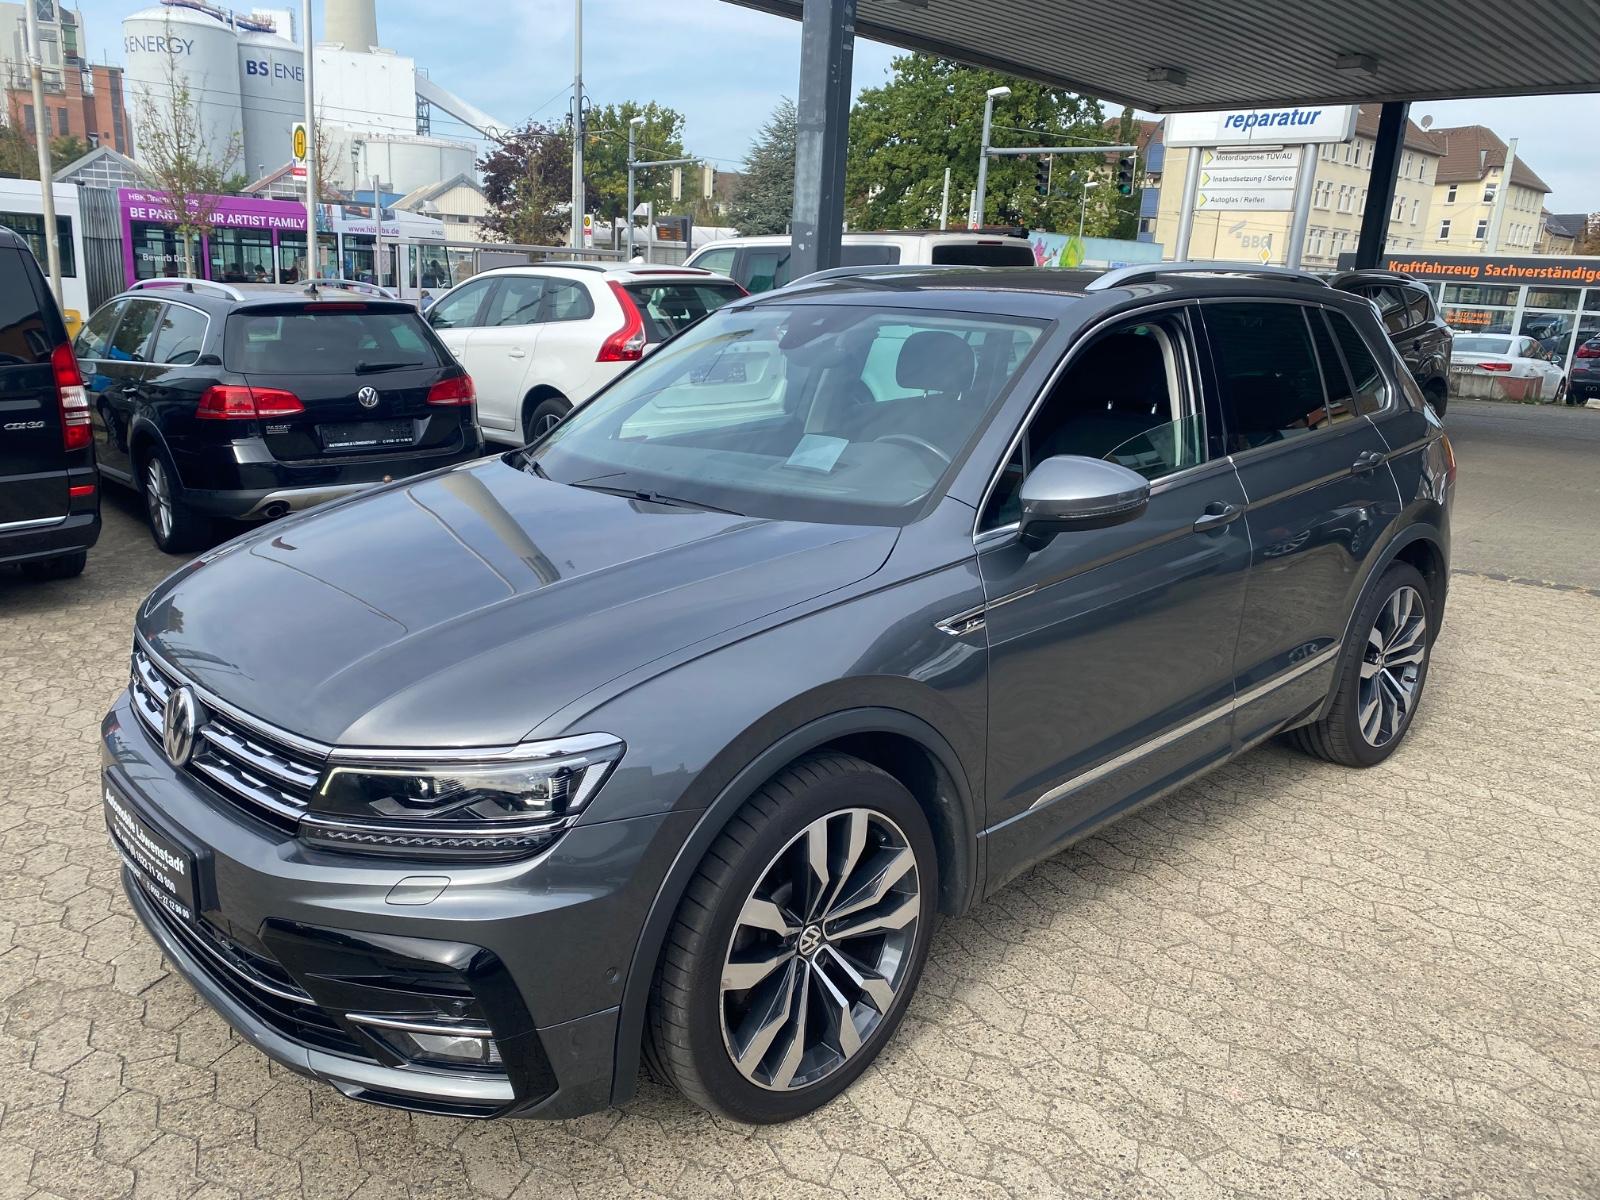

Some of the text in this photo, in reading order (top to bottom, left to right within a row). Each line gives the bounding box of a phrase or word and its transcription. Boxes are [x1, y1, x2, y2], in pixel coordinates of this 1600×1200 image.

[274, 63, 305, 82] ENE
[1224, 109, 1322, 132] reparatur
[1216, 154, 1265, 162] Motordiagnose
[1212, 175, 1262, 184] Instandsetzung
[1268, 175, 1293, 183] Service
[1210, 196, 1239, 204] Autoglas
[1244, 196, 1265, 204] Reifen
[129, 207, 146, 219] BE
[226, 214, 267, 226] ARTIST
[268, 216, 306, 229] FAMILY
[142, 253, 172, 263] Bewirb
[1388, 260, 1480, 278] Kraftfahrzeug
[135, 823, 185, 875] Löwenstadt
